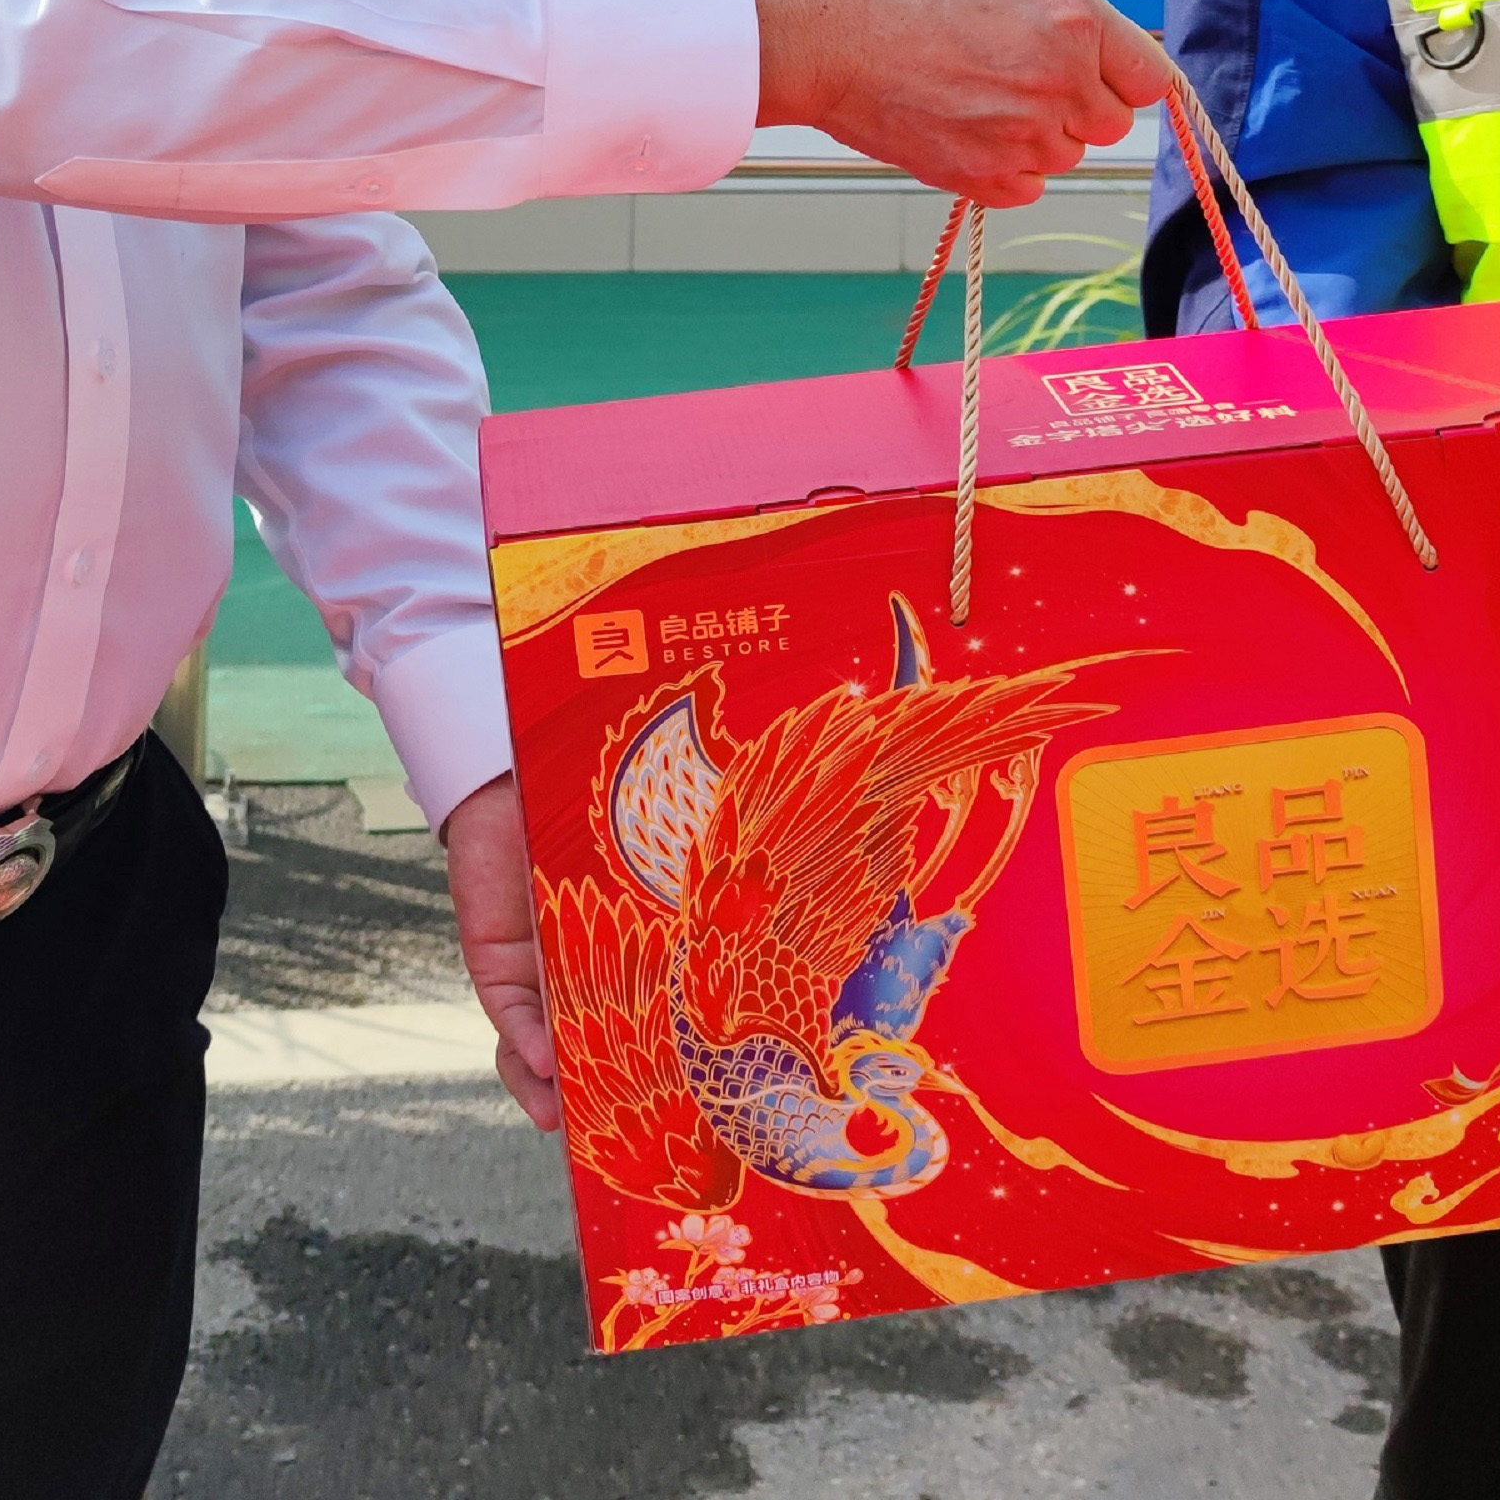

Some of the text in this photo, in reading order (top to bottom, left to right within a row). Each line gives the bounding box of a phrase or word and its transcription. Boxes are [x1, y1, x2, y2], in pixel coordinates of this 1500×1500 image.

[1062, 368, 1182, 396] 良品
[1072, 387, 1190, 412] 金选
[659, 603, 791, 644] 良品铺子
[662, 637, 791, 664] BESTORE
[1122, 778, 1366, 911] 良品
[1120, 894, 1384, 1026] 金选
[657, 1269, 840, 1306] 图案创意，非礼盒内容物
